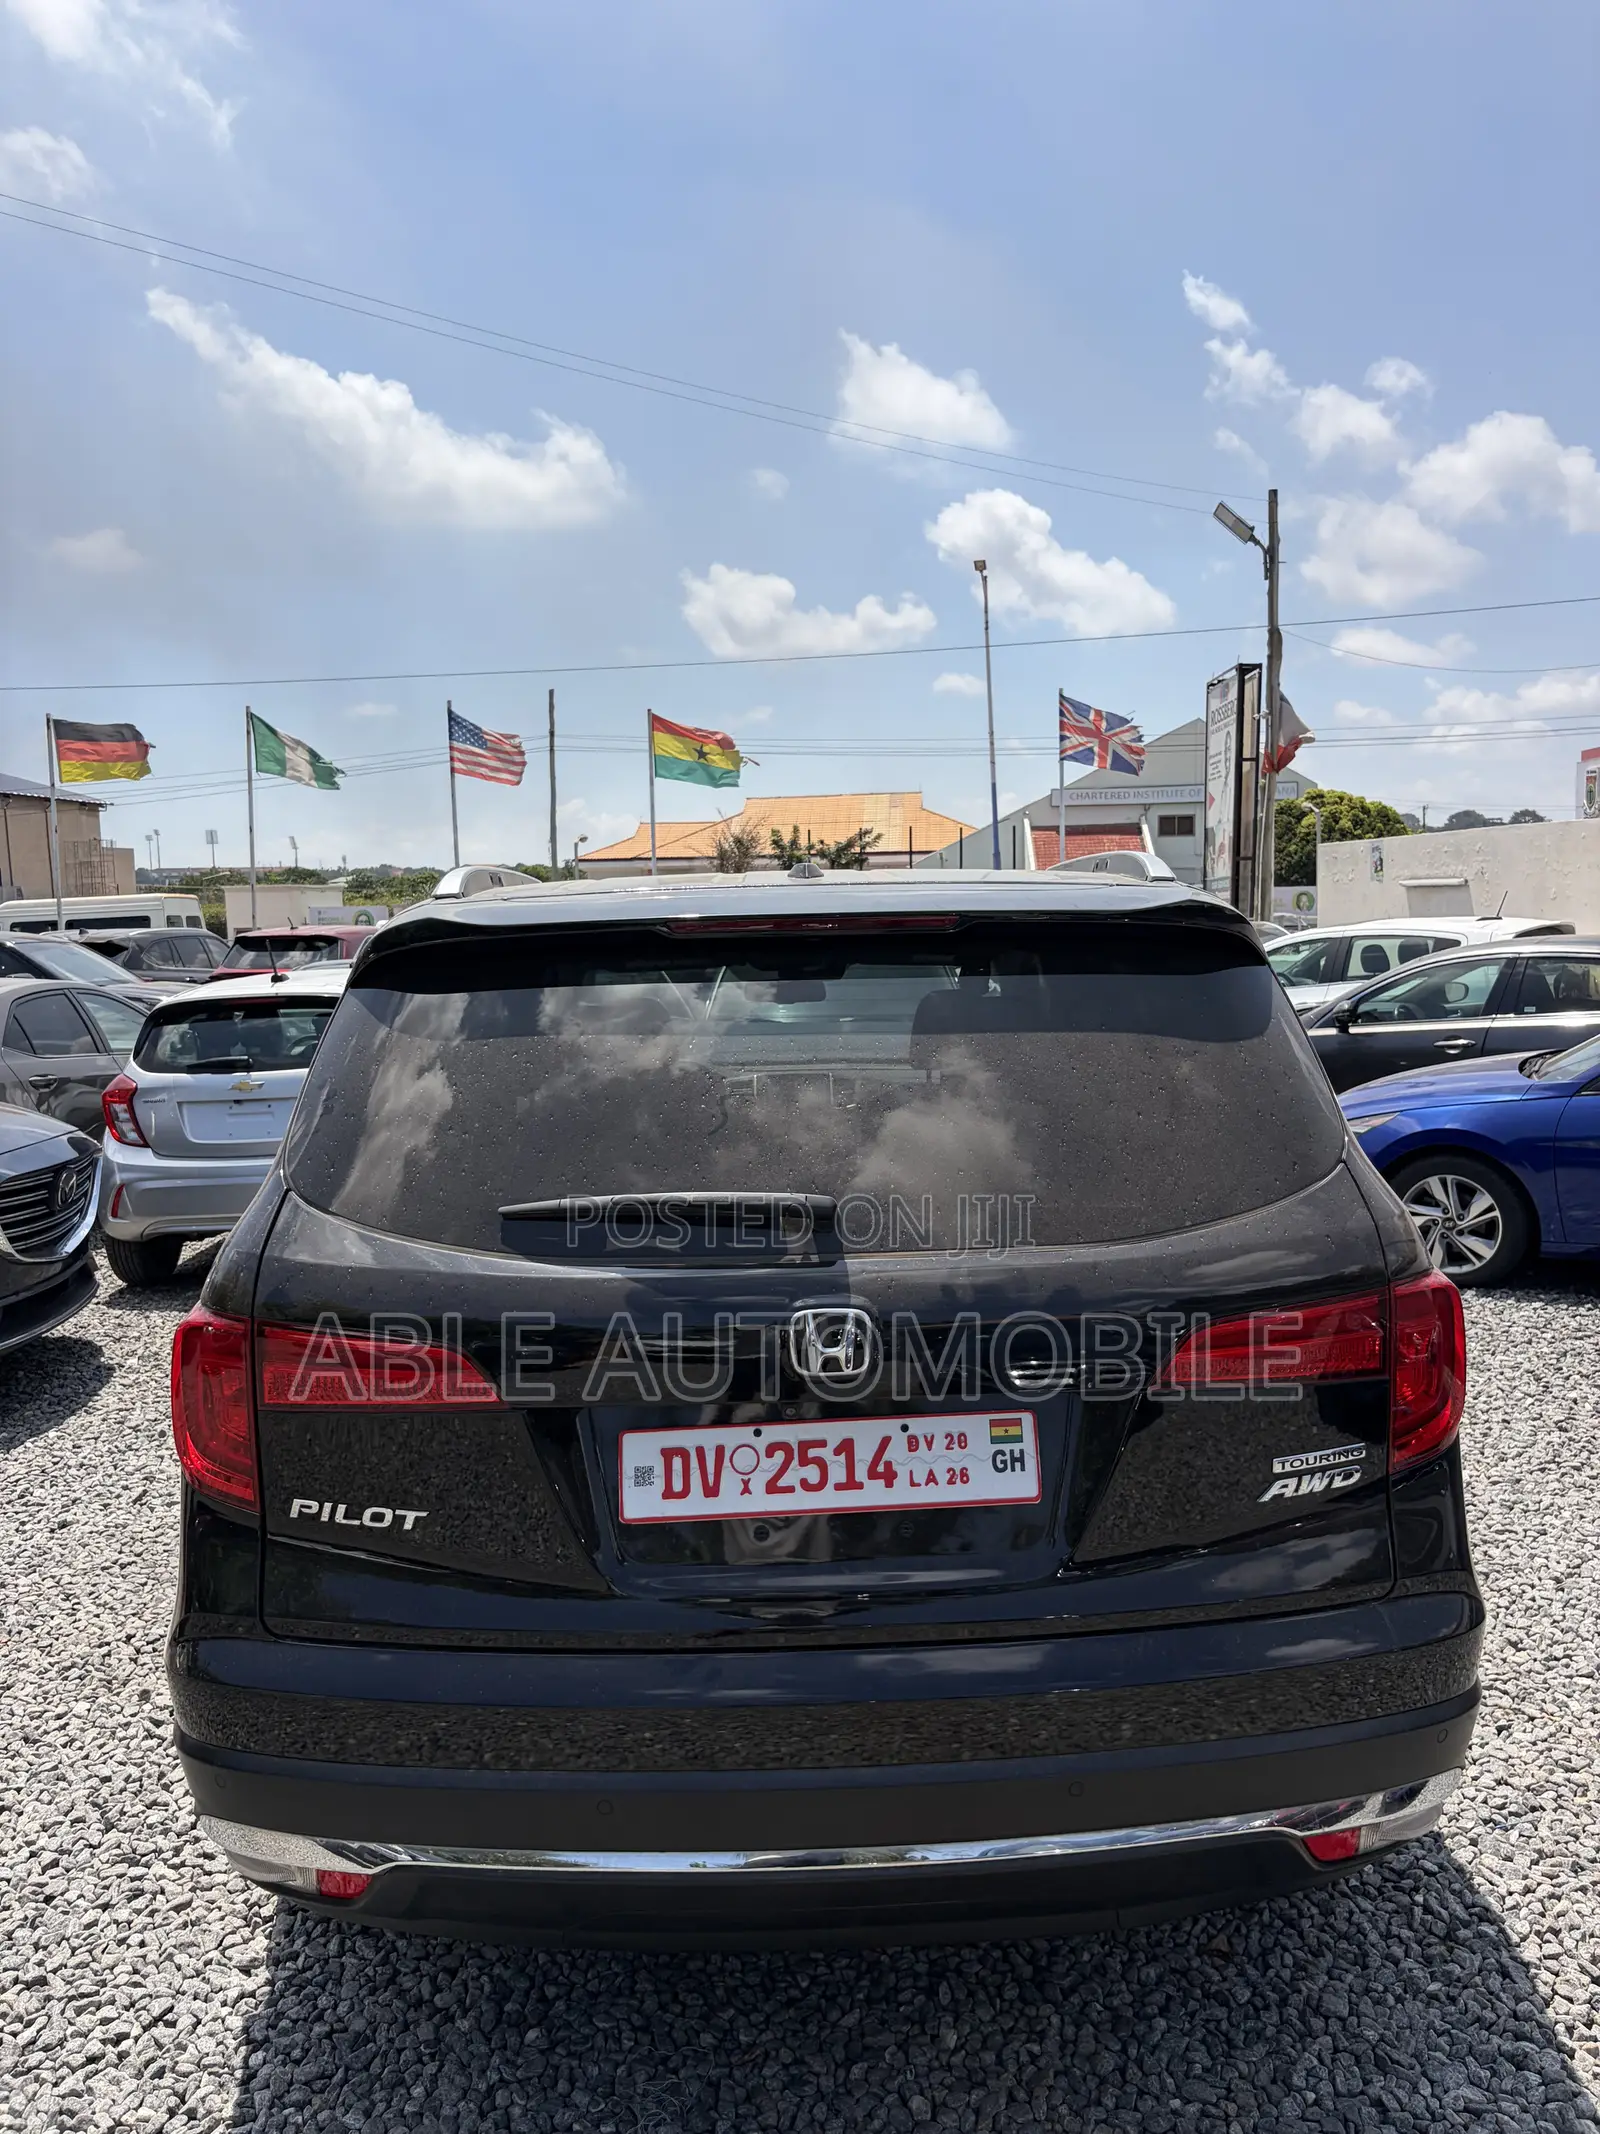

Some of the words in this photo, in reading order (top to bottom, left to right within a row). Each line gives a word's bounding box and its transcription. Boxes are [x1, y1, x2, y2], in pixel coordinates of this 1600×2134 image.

[1069, 791, 1130, 801] CHARTERED
[1133, 789, 1185, 800] INSTITUTE
[1188, 788, 1203, 798] OF
[1276, 785, 1296, 797] ANA
[660, 1444, 726, 1500] DV
[765, 1436, 899, 1495] 2514
[991, 1448, 1026, 1473] GH
[1277, 1446, 1364, 1471] TOURING
[909, 1468, 939, 1488] LA
[1259, 1465, 1362, 1502] AWD
[289, 1499, 429, 1530] PILOT
